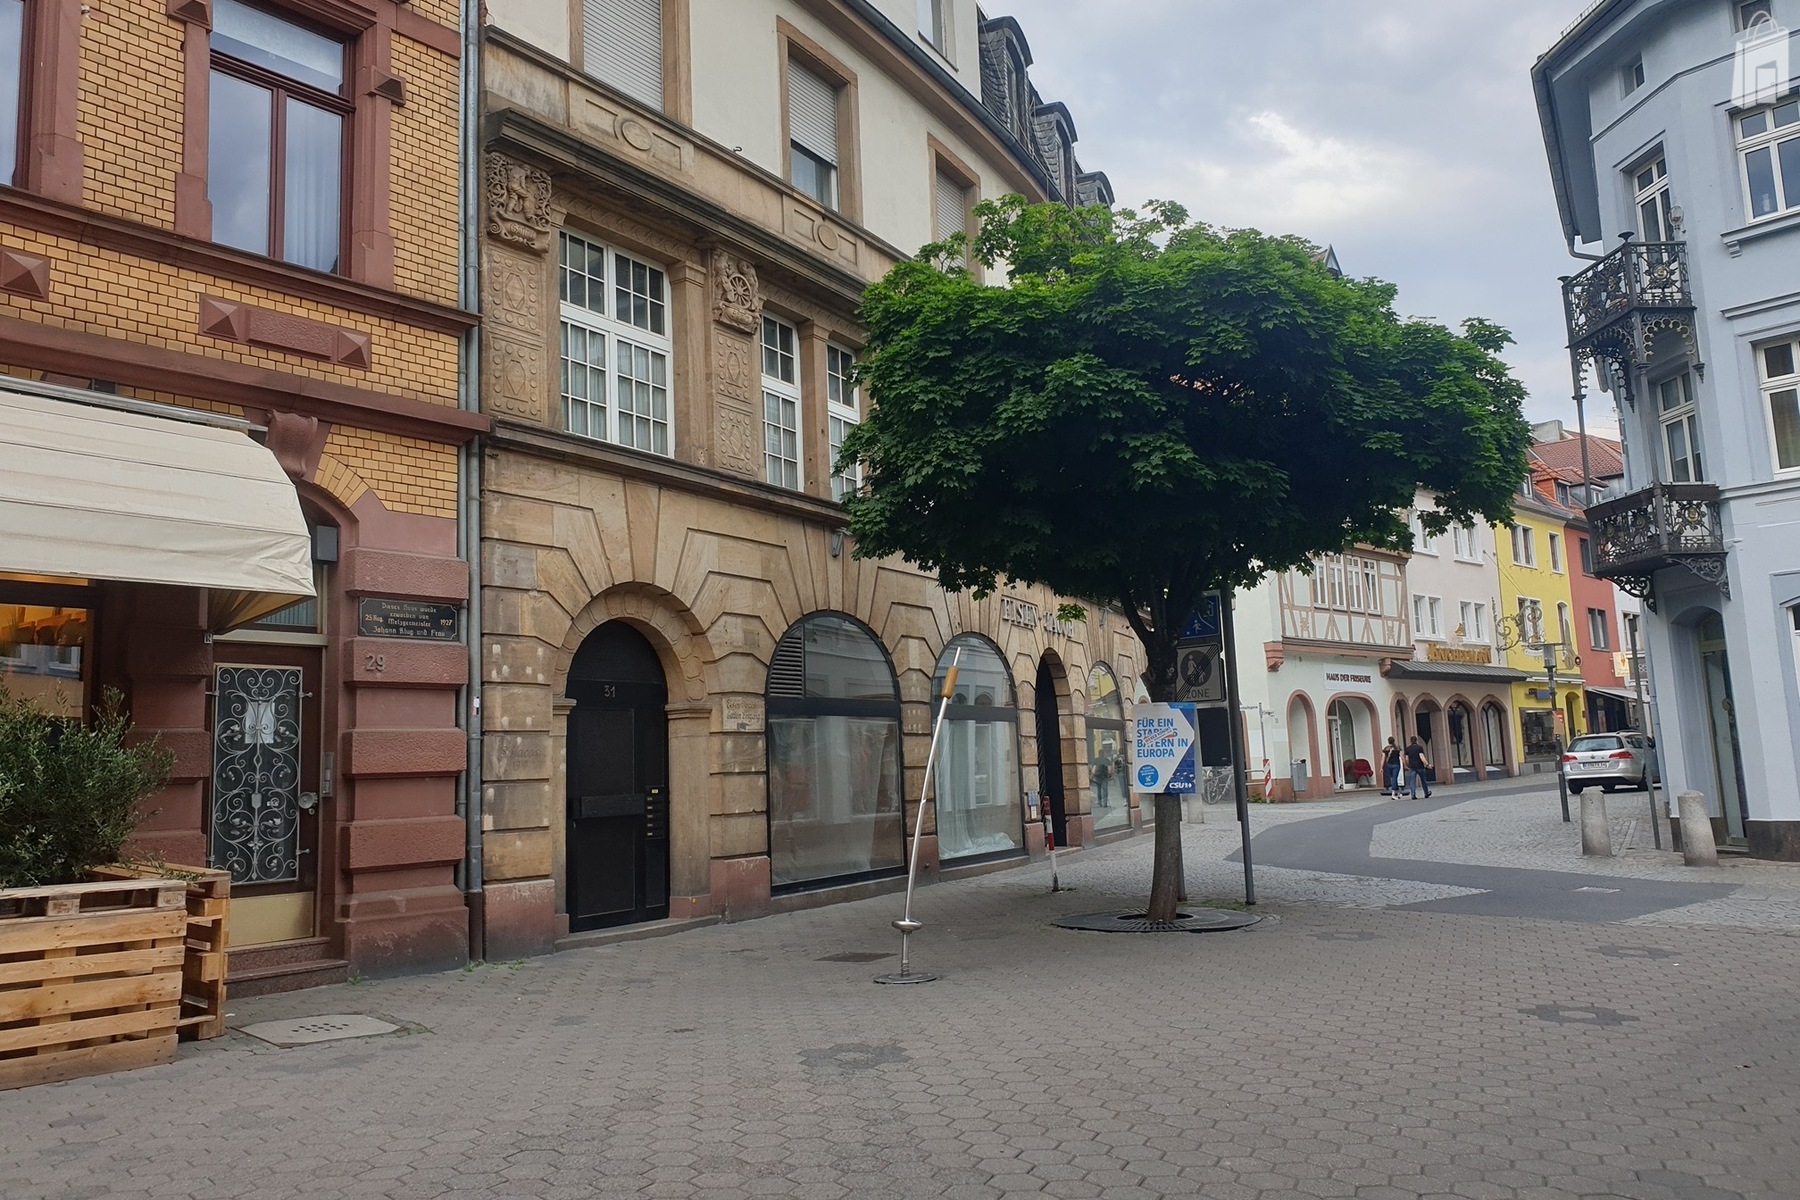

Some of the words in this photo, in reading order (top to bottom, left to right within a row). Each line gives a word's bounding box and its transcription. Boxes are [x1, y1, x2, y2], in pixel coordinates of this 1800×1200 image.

[1001, 598, 1037, 628] EISEN
[366, 653, 386, 672] 29
[1326, 672, 1339, 681] HAUS
[1340, 673, 1350, 682] DER
[1350, 674, 1372, 683] FRISEURE
[604, 684, 616, 698] 31
[1186, 688, 1210, 699] ZONE
[1137, 717, 1155, 728] FÜR
[1157, 718, 1174, 728] EIN
[1177, 738, 1188, 748] IN
[1137, 748, 1175, 758] EUROPA
